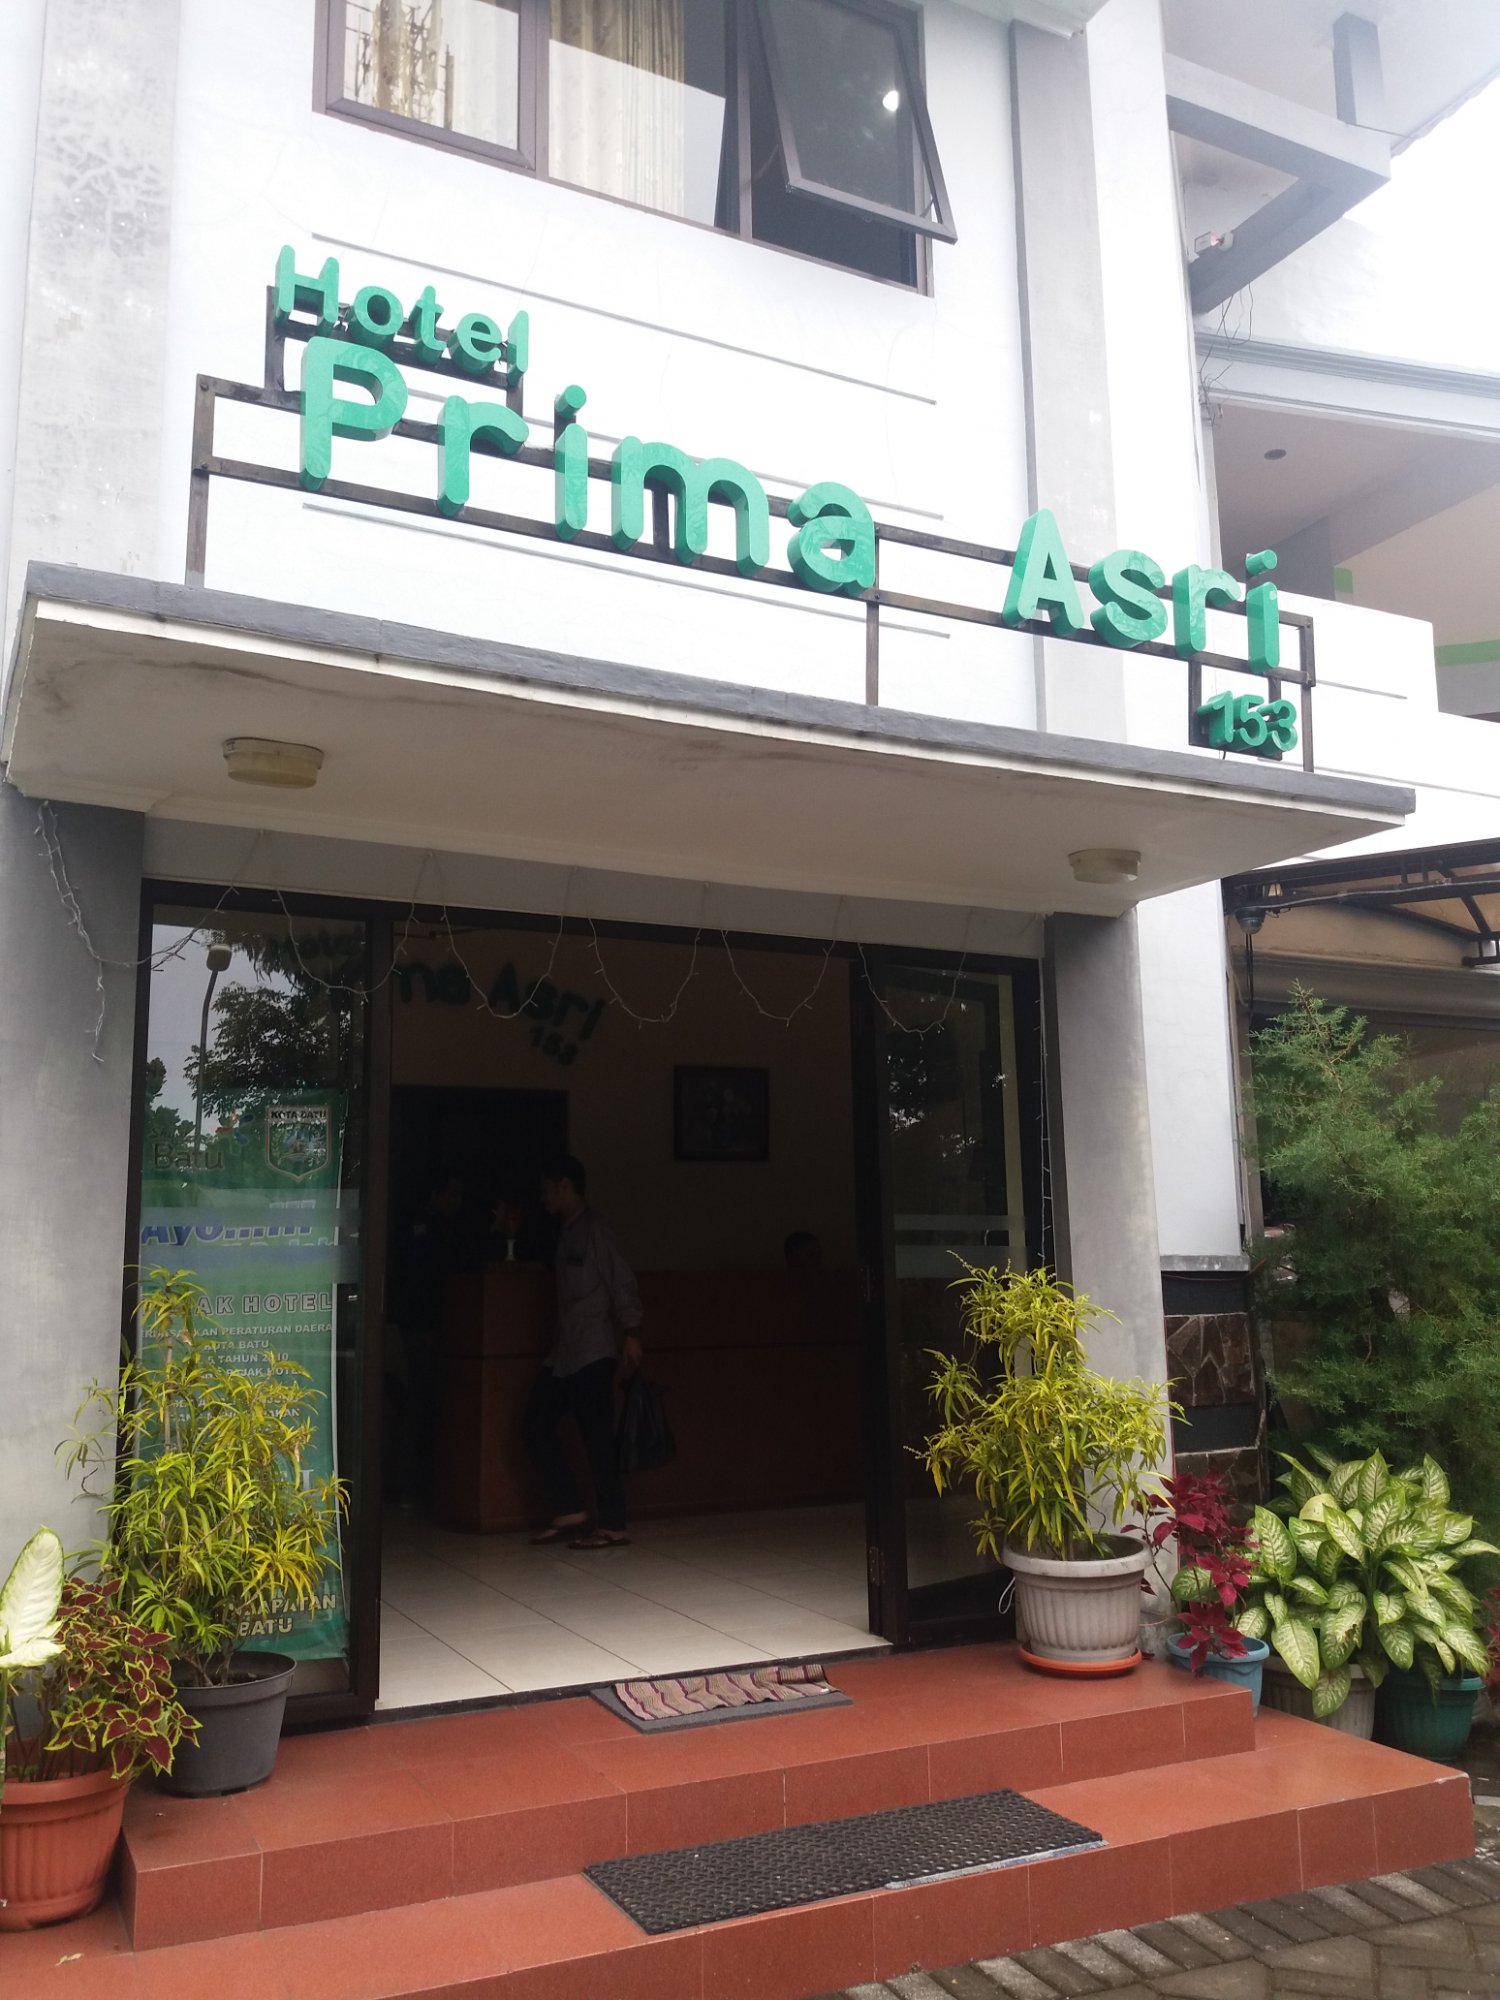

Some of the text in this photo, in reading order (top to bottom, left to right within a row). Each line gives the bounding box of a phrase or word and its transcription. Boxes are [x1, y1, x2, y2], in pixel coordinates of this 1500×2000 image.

[275, 244, 529, 386] Hotel
[300, 336, 1280, 674] Prima Asri
[1197, 690, 1298, 756] 153
[271, 1110, 297, 1119] KOTA
[154, 1143, 223, 1170] Batu
[242, 1291, 332, 1315] HOTEL
[222, 1325, 291, 1336] PERATURAN
[239, 1340, 270, 1349] BATU
[218, 1354, 258, 1364] TAHUN
[239, 1617, 292, 1637] BATU
